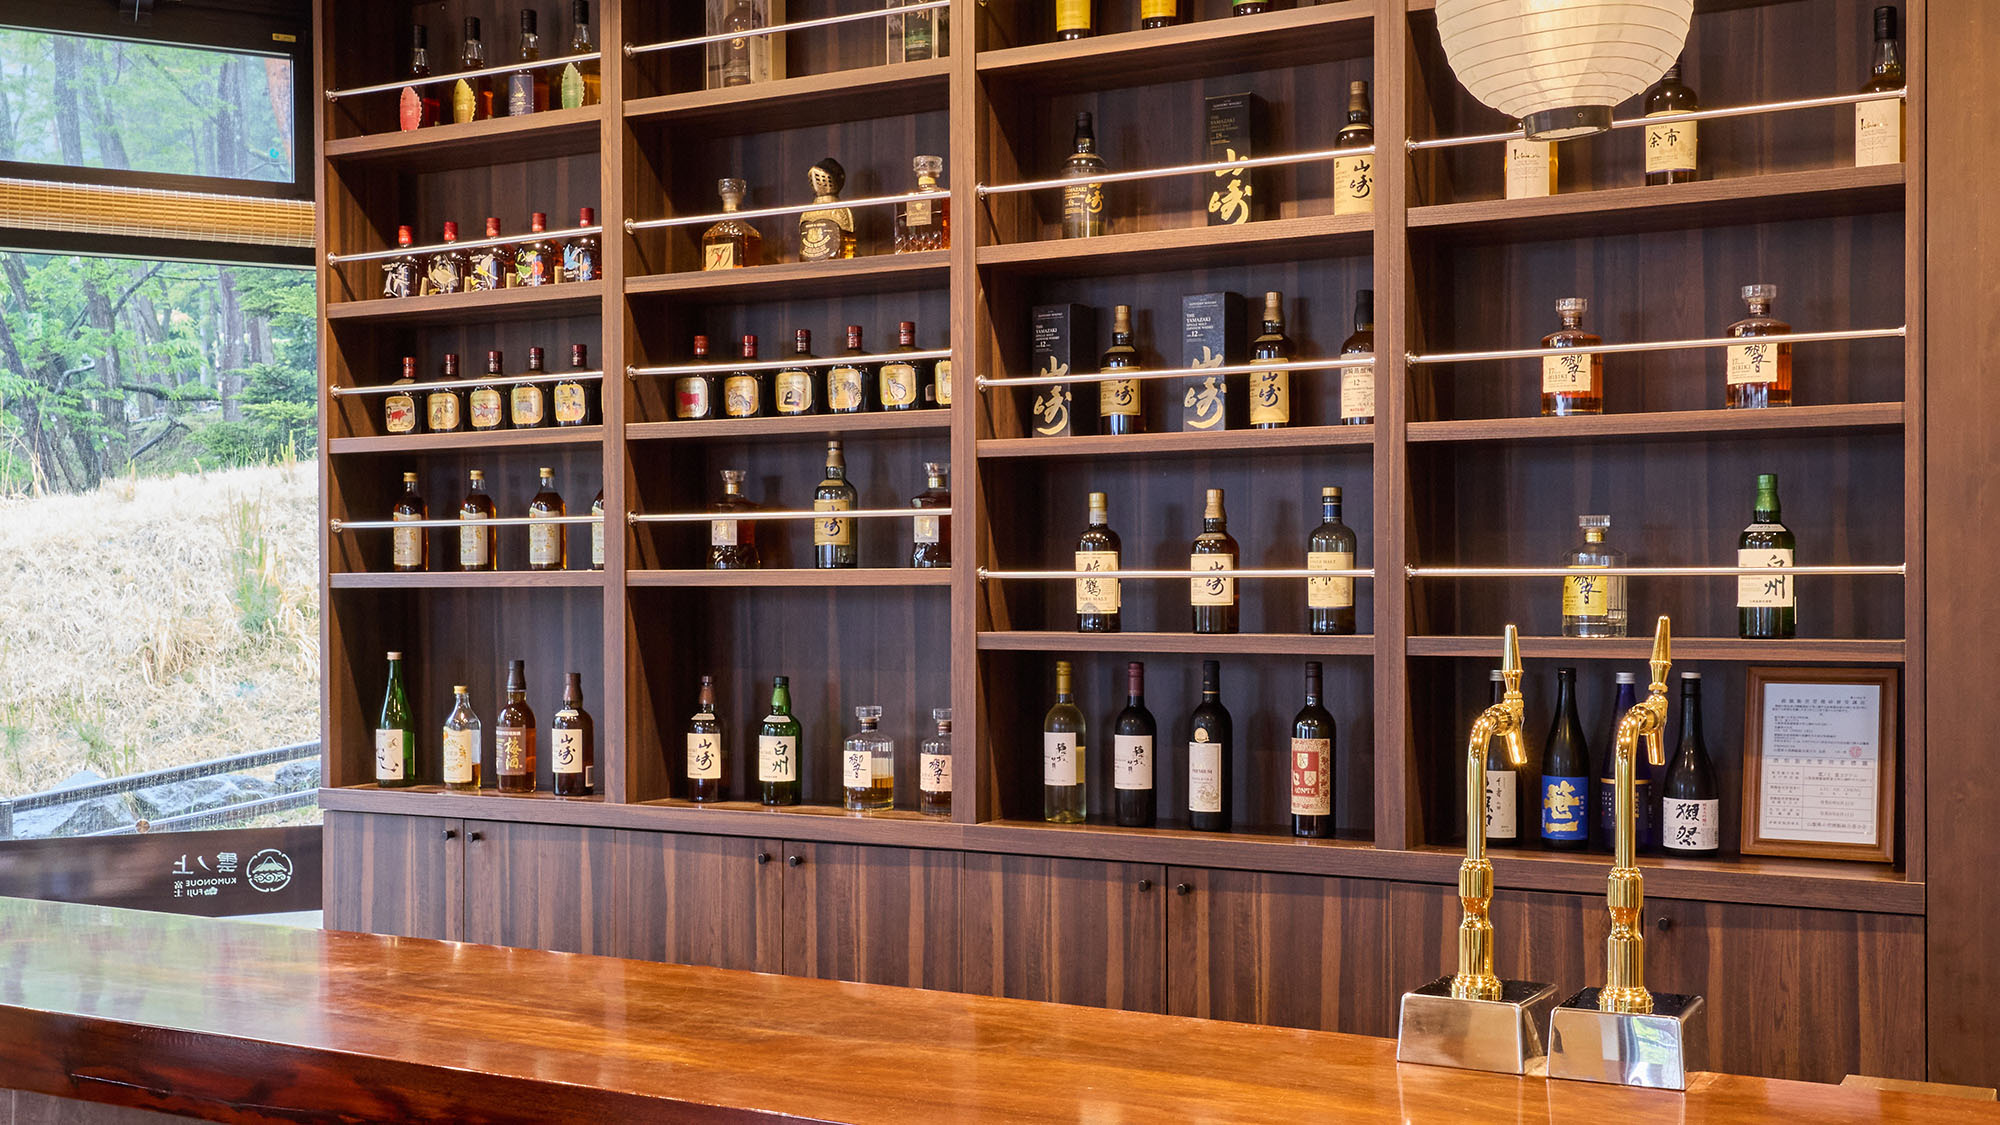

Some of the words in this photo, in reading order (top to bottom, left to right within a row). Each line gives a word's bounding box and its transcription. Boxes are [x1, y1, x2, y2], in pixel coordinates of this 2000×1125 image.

[1648, 128, 1680, 148] 余市
[1350, 159, 1373, 199] 山崎
[1034, 356, 1072, 436] 山崎
[1184, 346, 1228, 429] 山崎
[1258, 371, 1282, 408] 山崎
[1206, 560, 1227, 596] 山崎
[504, 736, 523, 770] 梅酒
[558, 734, 576, 766] 山崎
[696, 738, 714, 770] 山崎
[772, 740, 790, 776] 白州
[1544, 780, 1580, 834] 笹一
[1676, 803, 1701, 846] 獺祭
